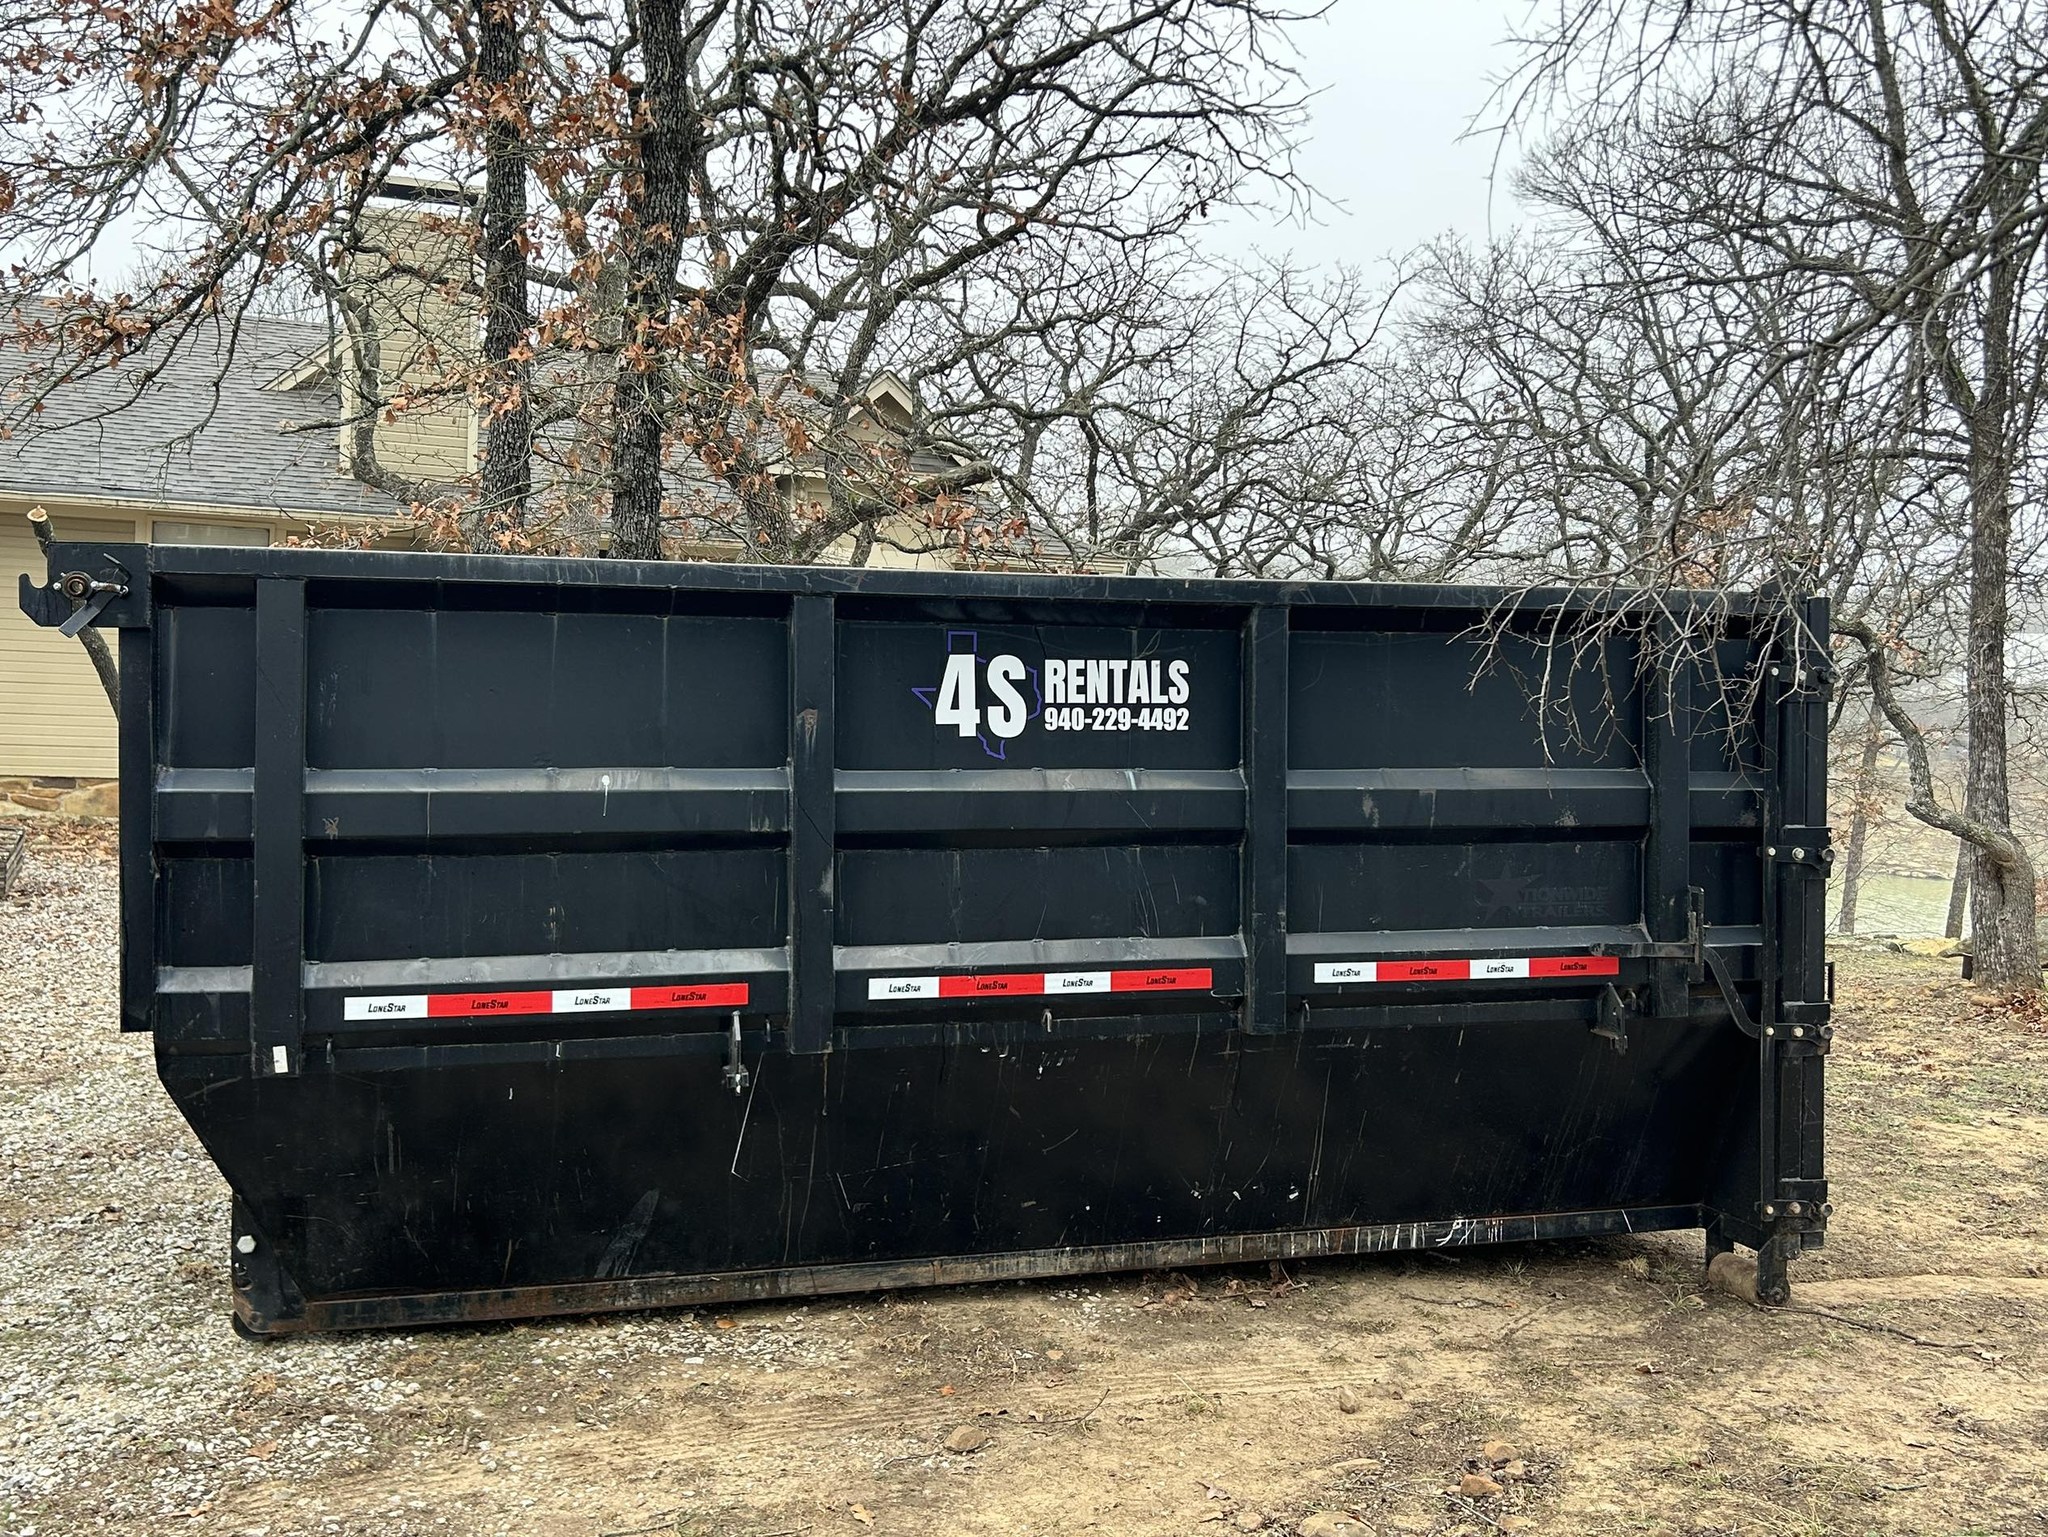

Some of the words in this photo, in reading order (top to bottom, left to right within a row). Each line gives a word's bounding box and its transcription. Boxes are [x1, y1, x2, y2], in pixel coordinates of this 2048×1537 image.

[935, 654, 1028, 738] 4S
[1044, 659, 1190, 705] RENTALS
[1044, 707, 1190, 731] 940-229-4492
